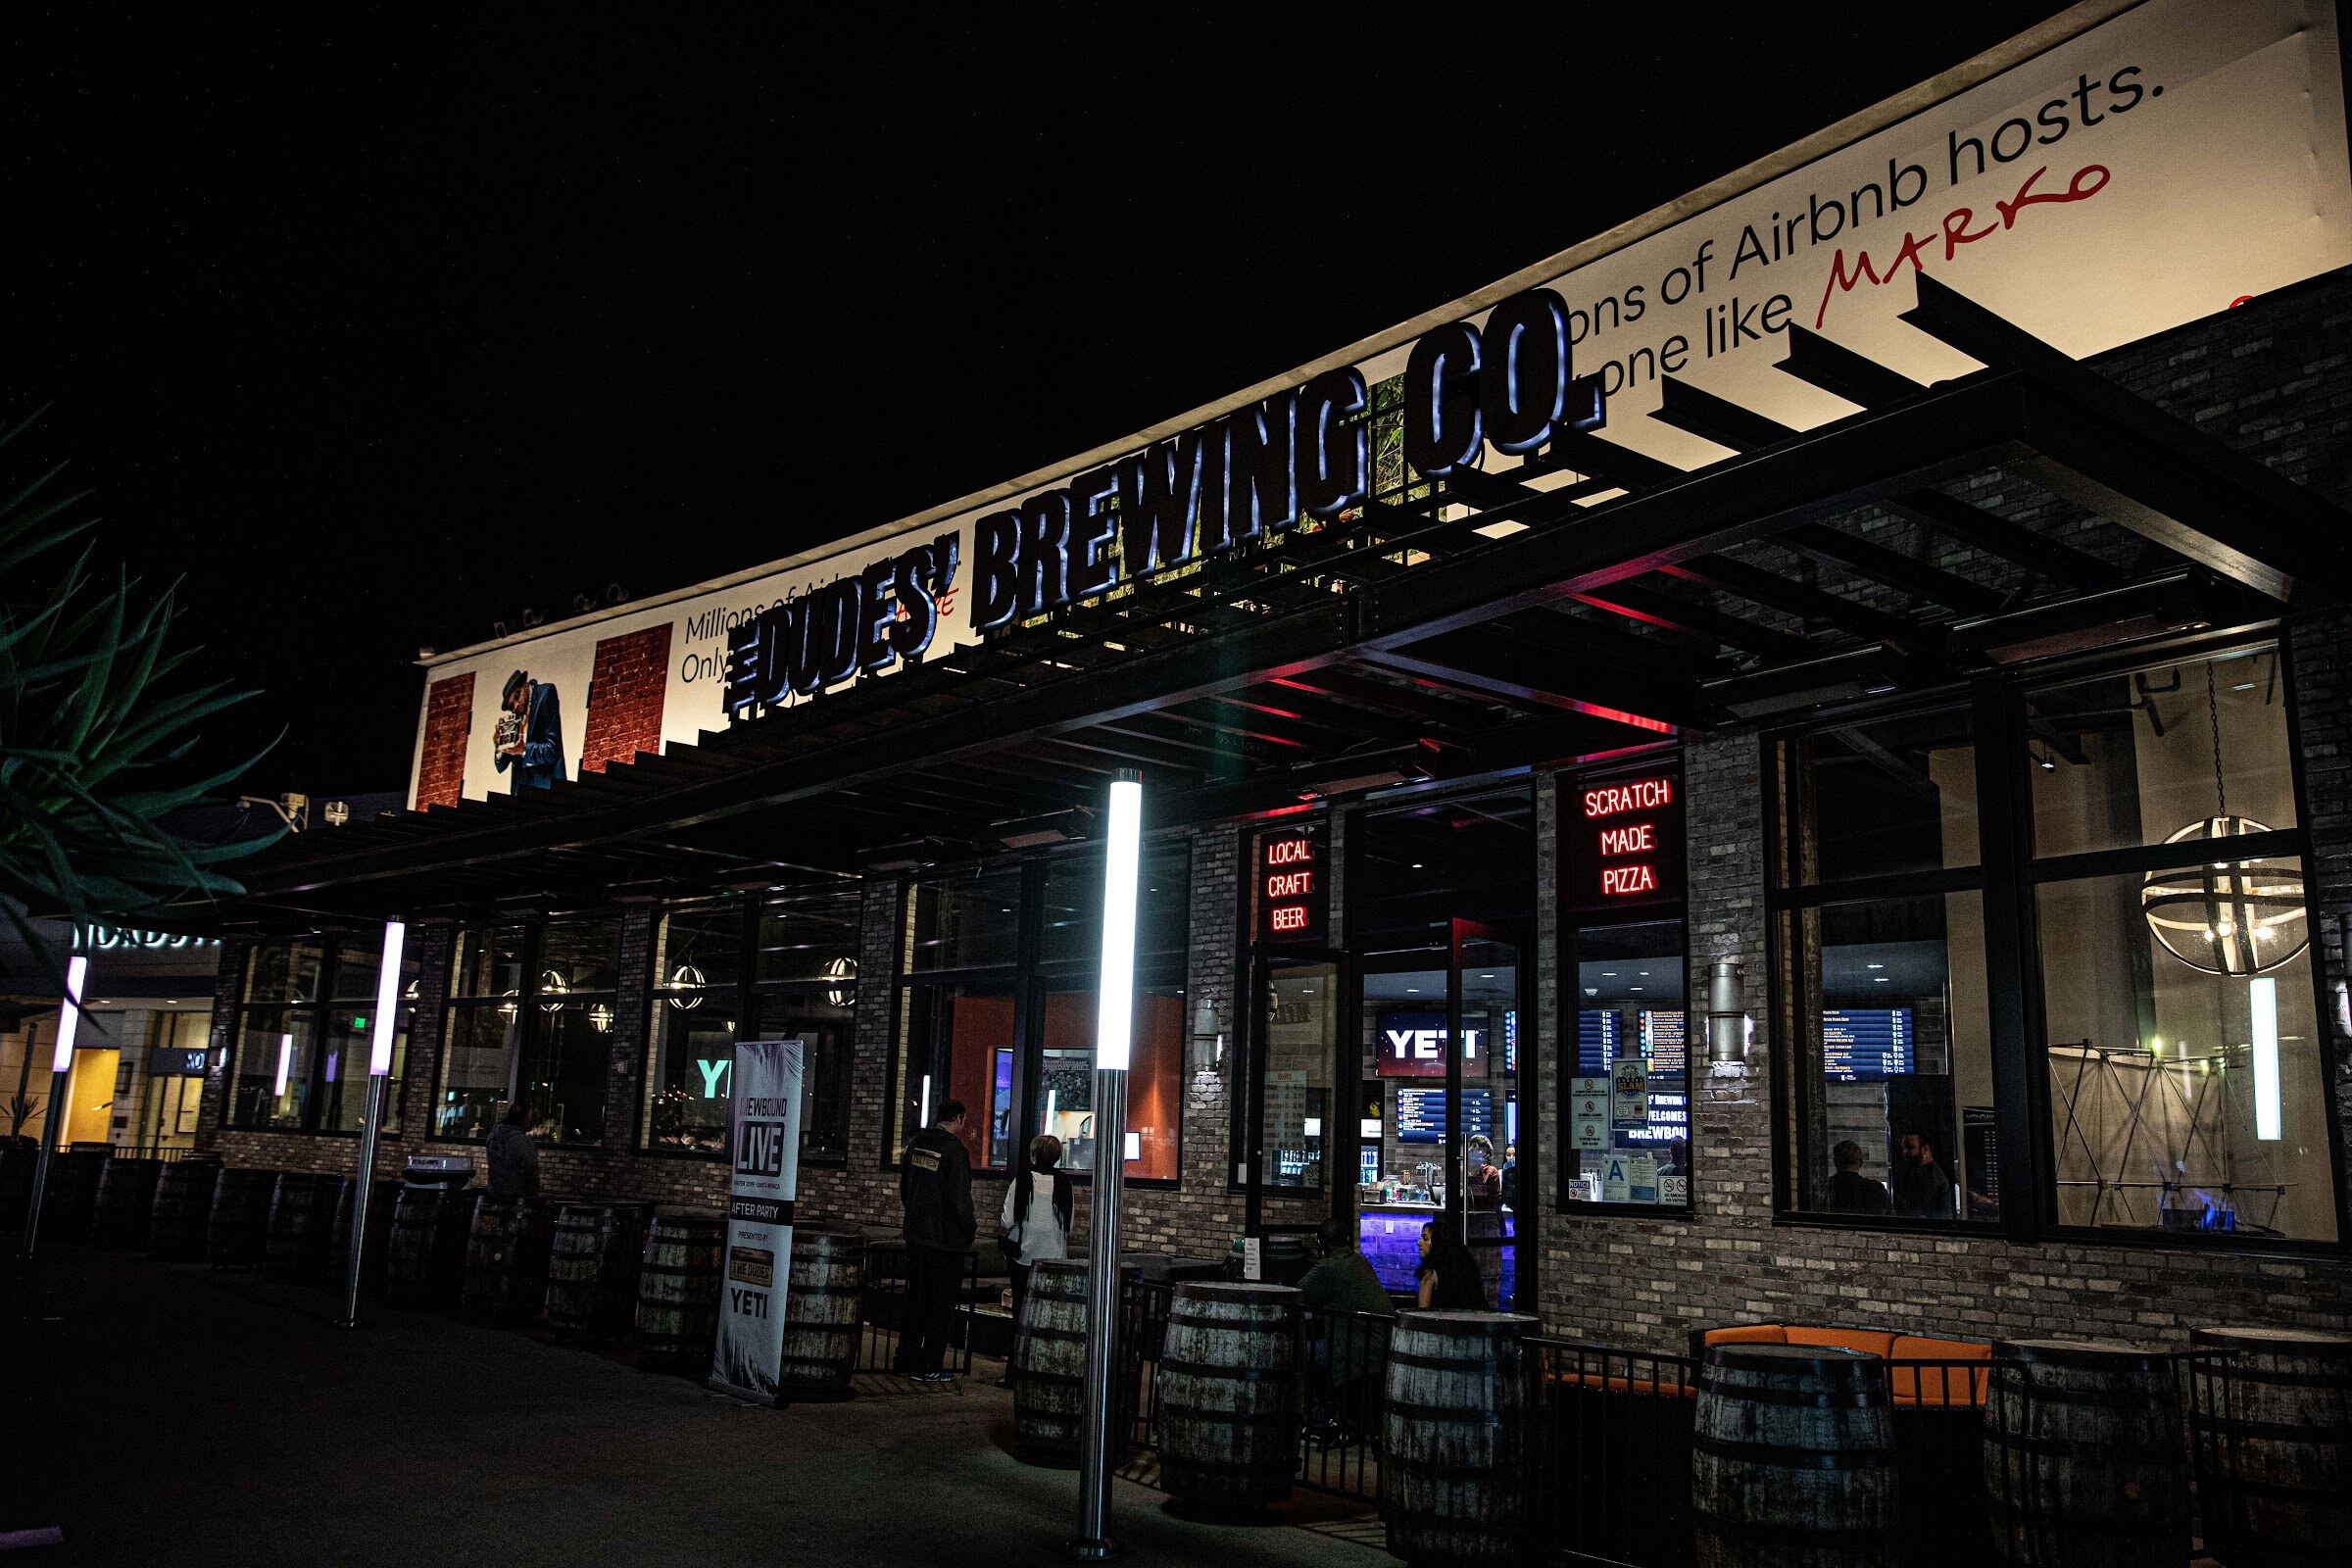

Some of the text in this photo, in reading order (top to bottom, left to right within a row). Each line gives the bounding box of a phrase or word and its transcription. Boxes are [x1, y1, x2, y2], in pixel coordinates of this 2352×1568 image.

[1660, 239, 1714, 306] of
[1729, 158, 1928, 281] Airbnb
[1947, 65, 2165, 186] hosts.
[1705, 293, 1793, 359] like
[1816, 164, 2111, 329] MARKO
[722, 620, 761, 715] THE
[969, 366, 1370, 636] BREWING
[1405, 288, 1607, 479] CO.
[1586, 779, 1668, 816] SCRATCH
[1268, 839, 1310, 864] LOCAL
[1601, 824, 1652, 856] MADE
[1268, 871, 1310, 898] CRAFT
[1603, 865, 1653, 895] PIZZA
[1273, 906, 1305, 930] BEER
[1617, 1081, 1645, 1092] SLAM
[737, 1126, 783, 1173] LIVE
[1608, 1159, 1625, 1181] A
[731, 1201, 779, 1220] AFTER PARTY
[738, 1230, 762, 1242] PRESENTED
[732, 1260, 747, 1276] THE
[730, 1287, 768, 1319] YETI
